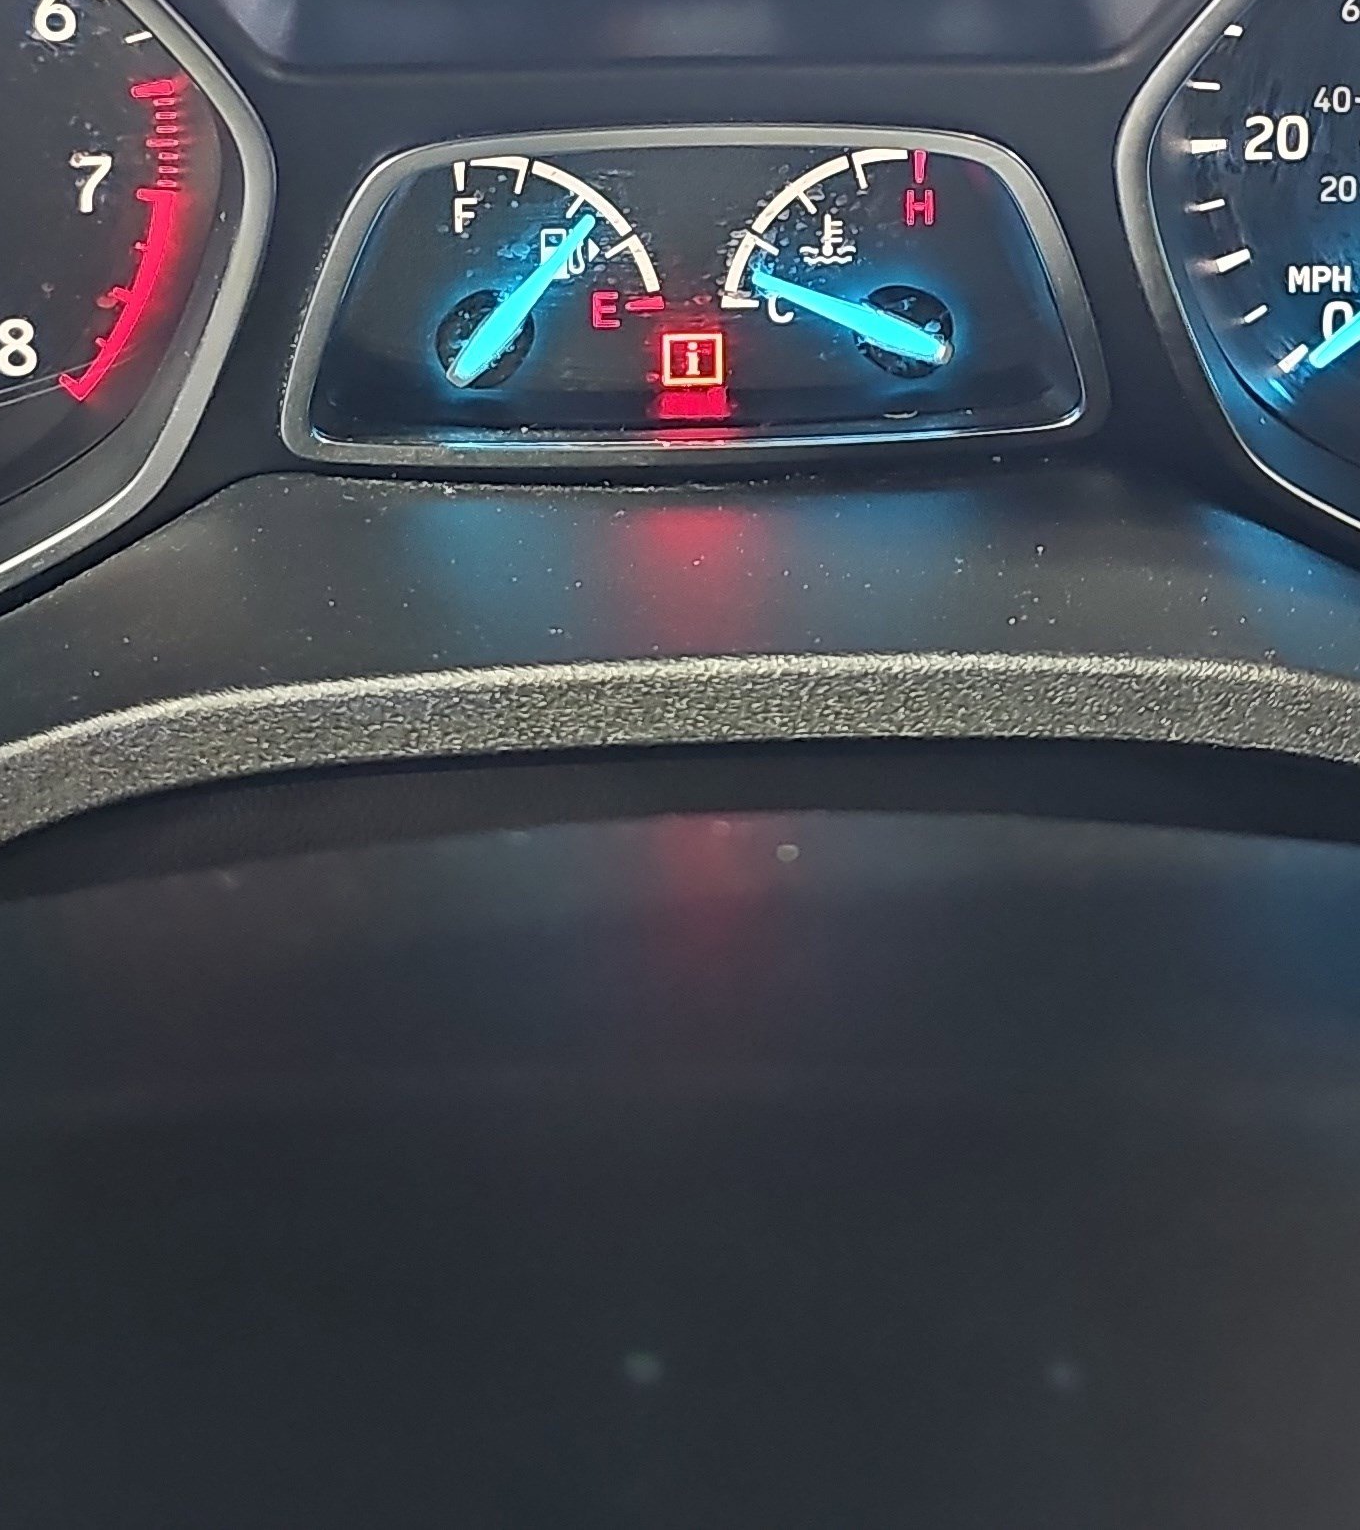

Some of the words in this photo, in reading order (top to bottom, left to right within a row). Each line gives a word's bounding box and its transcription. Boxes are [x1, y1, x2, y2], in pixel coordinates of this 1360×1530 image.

[1313, 86, 1351, 113] 40
[1244, 115, 1309, 161] 20
[69, 152, 112, 213] 7
[1320, 175, 1357, 203] 20
[453, 197, 478, 234] F
[904, 189, 936, 228] H
[1288, 264, 1352, 294] MPH
[592, 292, 621, 329] E
